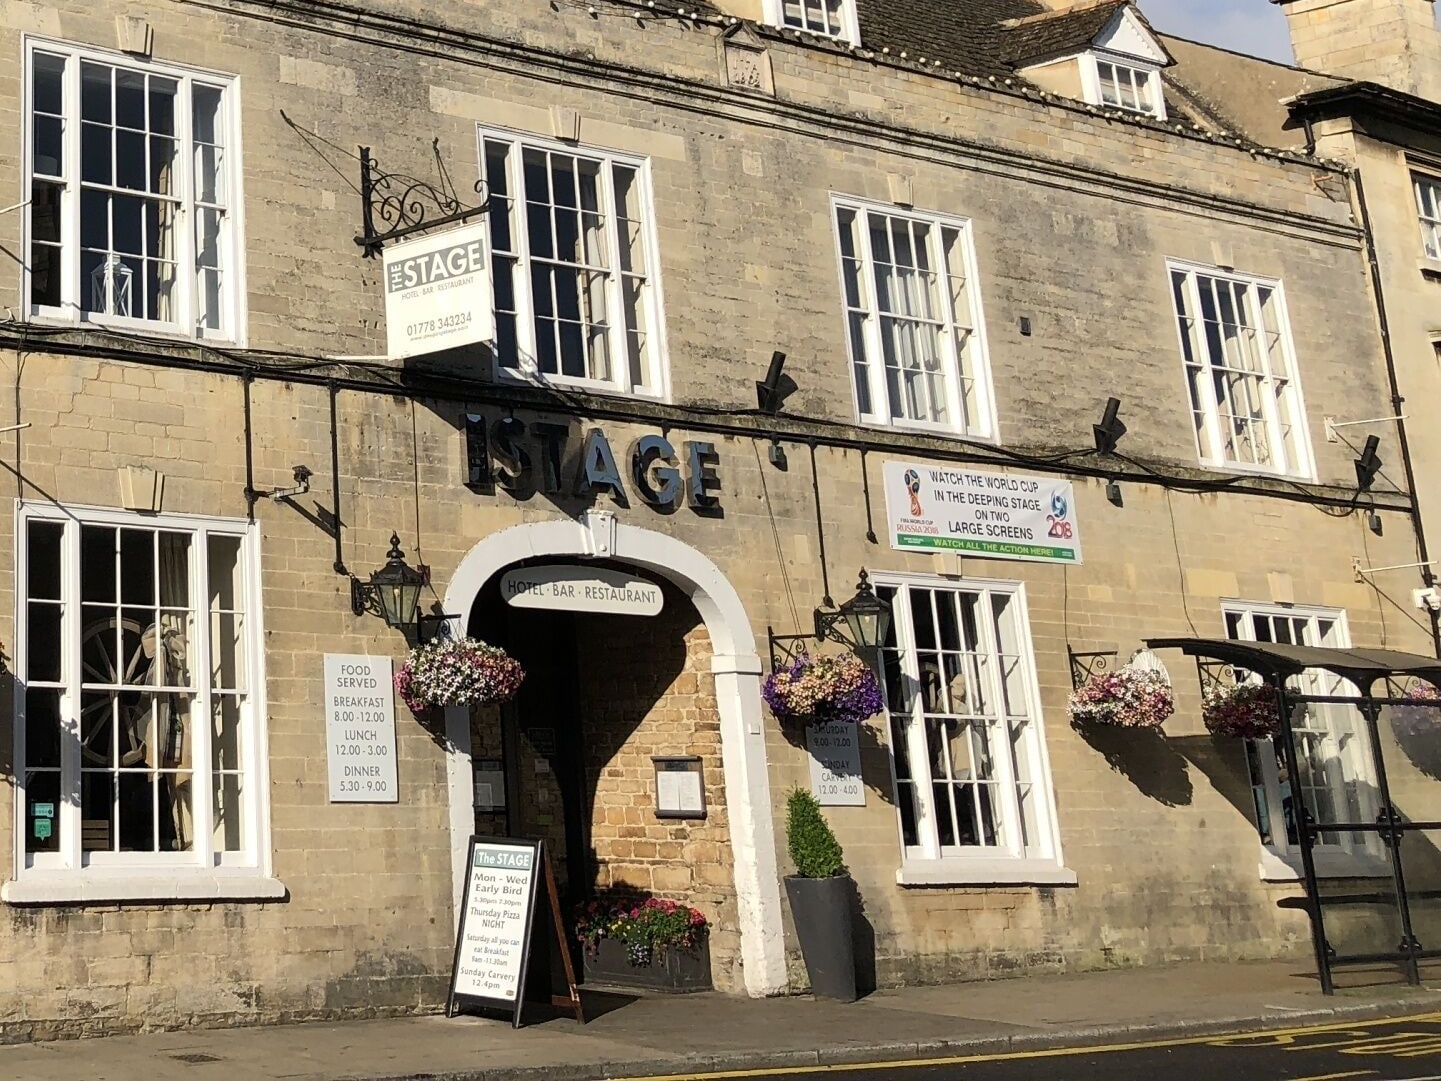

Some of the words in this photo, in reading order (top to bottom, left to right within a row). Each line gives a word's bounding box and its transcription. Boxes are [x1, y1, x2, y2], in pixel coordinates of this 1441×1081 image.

[404, 242, 482, 287] STAGE
[391, 264, 402, 292] THE
[402, 291, 419, 300] HOTEL
[422, 286, 433, 295] BAR
[438, 276, 474, 290] RESTAURANT
[407, 320, 434, 336] 01778
[438, 312, 472, 329] 343234
[929, 470, 964, 486] WATCH
[965, 475, 984, 488] THE
[985, 477, 1018, 491] WORLD
[1020, 480, 1038, 493] CUP
[934, 490, 944, 501] IN
[946, 491, 966, 503] THE
[968, 493, 1008, 508] DEEPING
[1011, 498, 1041, 511] STAGE
[975, 510, 988, 520] ON
[990, 511, 1010, 522] TWO
[897, 524, 922, 532] RUSSIA
[949, 521, 983, 535] LARGE
[986, 524, 1033, 540] SCREENS
[933, 538, 964, 548] WATCH
[966, 541, 980, 549] ALL
[1000, 544, 1028, 553] ACTION
[1030, 547, 1053, 556] HERE!
[508, 580, 544, 595] HOTEL
[553, 584, 574, 597] BAR
[585, 586, 656, 604] RESTAURANT
[341, 665, 370, 675] FOOD
[337, 678, 377, 688] SERVED
[334, 696, 384, 708] BREAKFAST
[334, 711, 354, 722] 8.00
[345, 730, 377, 740] LUNCH
[336, 745, 360, 755] 12.00
[368, 745, 387, 755] 3.00
[345, 766, 380, 776] DINNER
[340, 781, 360, 791] 5.30
[367, 781, 386, 792] 9.00
[819, 785, 837, 794] 12.00
[844, 785, 858, 794] 4.00
[479, 852, 495, 864] The
[497, 853, 530, 867] STAGE
[474, 873, 495, 882] Mon
[506, 875, 528, 884] Wed
[476, 884, 499, 895] Early
[503, 886, 522, 895] Bird
[470, 907, 501, 919] Thursday
[503, 910, 520, 919] Pizza
[482, 919, 505, 929] NIGHT
[467, 933, 490, 944] Saturday
[484, 947, 509, 956] Breakfast
[460, 967, 485, 978] Sunday
[488, 970, 516, 982] Carvery
